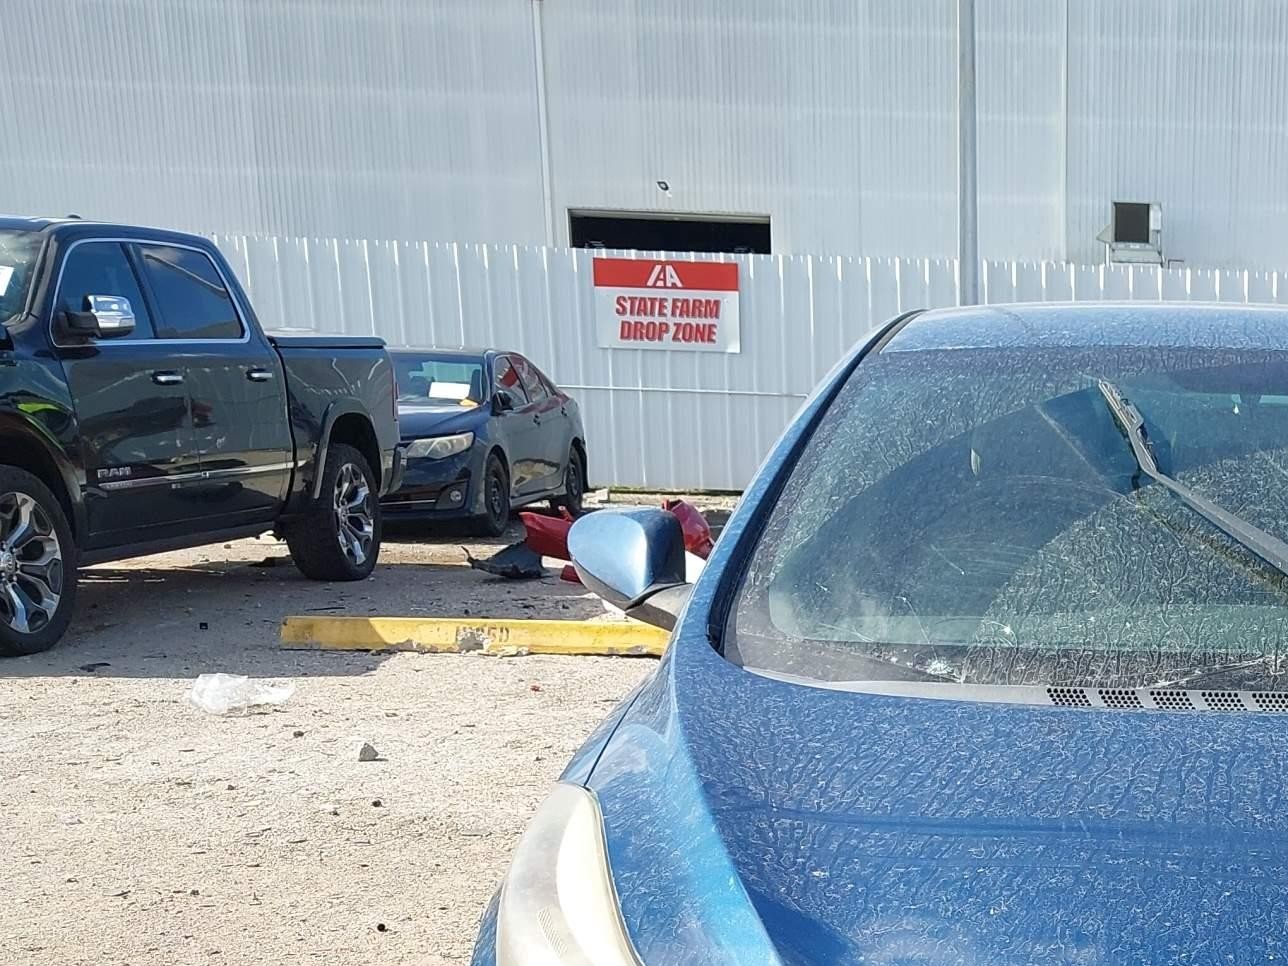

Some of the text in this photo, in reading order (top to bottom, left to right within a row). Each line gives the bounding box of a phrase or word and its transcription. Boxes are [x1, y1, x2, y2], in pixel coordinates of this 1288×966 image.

[615, 296, 721, 319] STATE FARM
[620, 321, 717, 343] DROP ZONE
[97, 466, 132, 478] RAM
